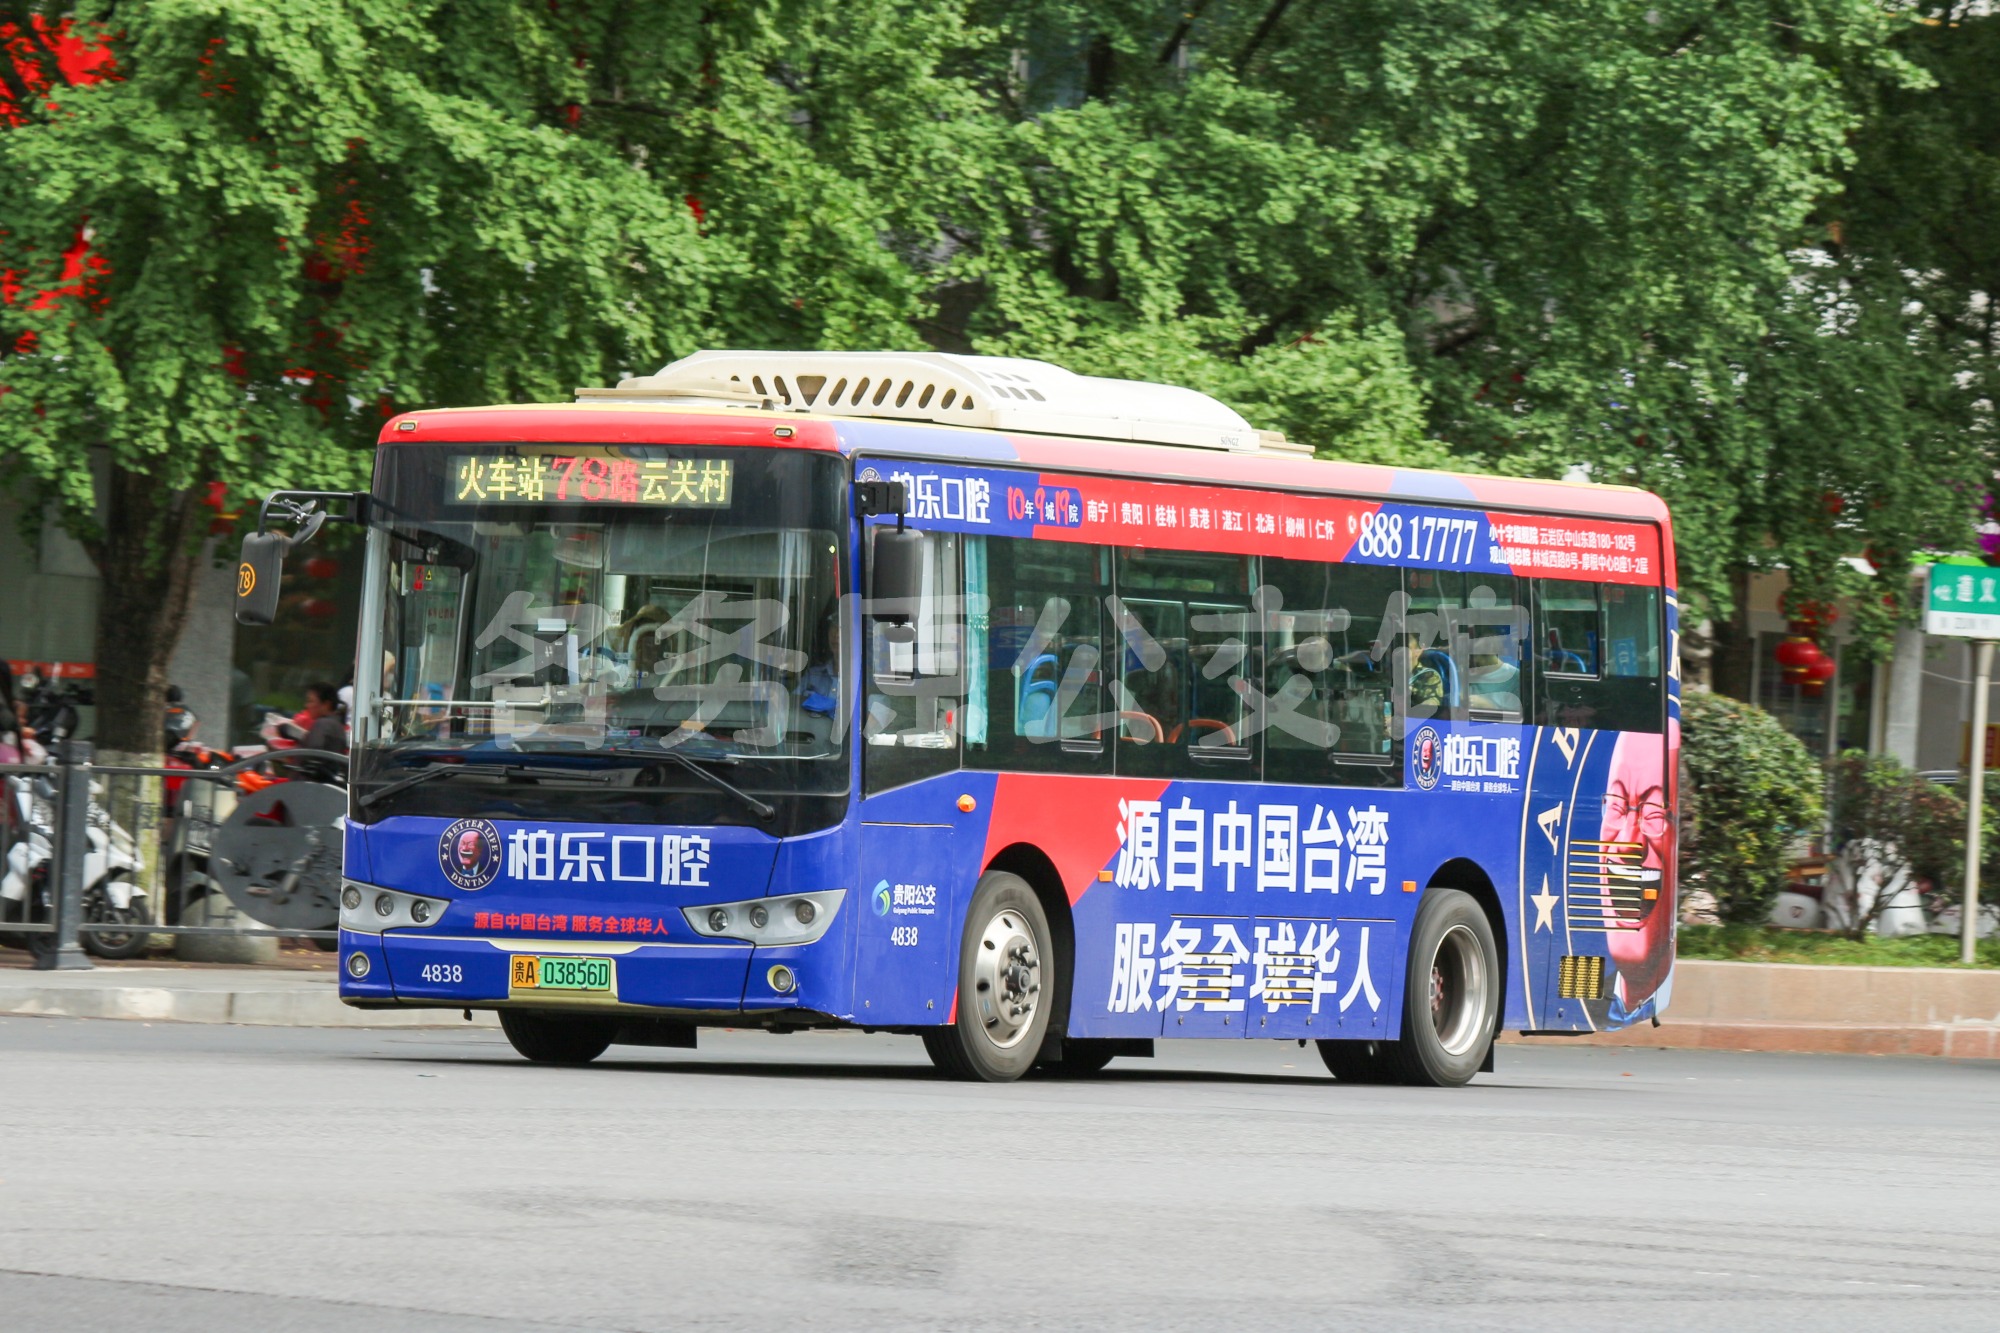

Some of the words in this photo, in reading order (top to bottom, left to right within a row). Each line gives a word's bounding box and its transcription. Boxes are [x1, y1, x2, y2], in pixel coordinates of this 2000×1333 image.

[1087, 500, 1109, 522] 南宁
[1121, 502, 1143, 525] 贵阳
[1155, 505, 1177, 528] 桂林
[1189, 507, 1210, 530] 贵港
[1222, 510, 1243, 532] 湛江
[1255, 513, 1275, 534] 北海
[1285, 516, 1305, 539] 柳州
[1315, 518, 1335, 540] 仁怀
[1358, 511, 1402, 559] 888
[1407, 516, 1478, 565] 17777
[240, 571, 250, 589] 78
[1443, 733, 1520, 779] 柏乐口腔
[446, 820, 484, 840] BETTER
[484, 828, 499, 851] LIFE
[1114, 796, 1389, 895] 源自中国台湾
[507, 829, 711, 886] 柏乐口腔
[451, 872, 490, 887] DENTAL
[893, 884, 936, 906] 贵阳公交
[474, 912, 568, 931] 源自中国台湾
[572, 915, 669, 935] 服务全球华人
[890, 926, 918, 946] 4838
[421, 964, 462, 983] 4838
[544, 962, 608, 985] 03856D
[1107, 920, 1382, 1014] 服务全球华人
